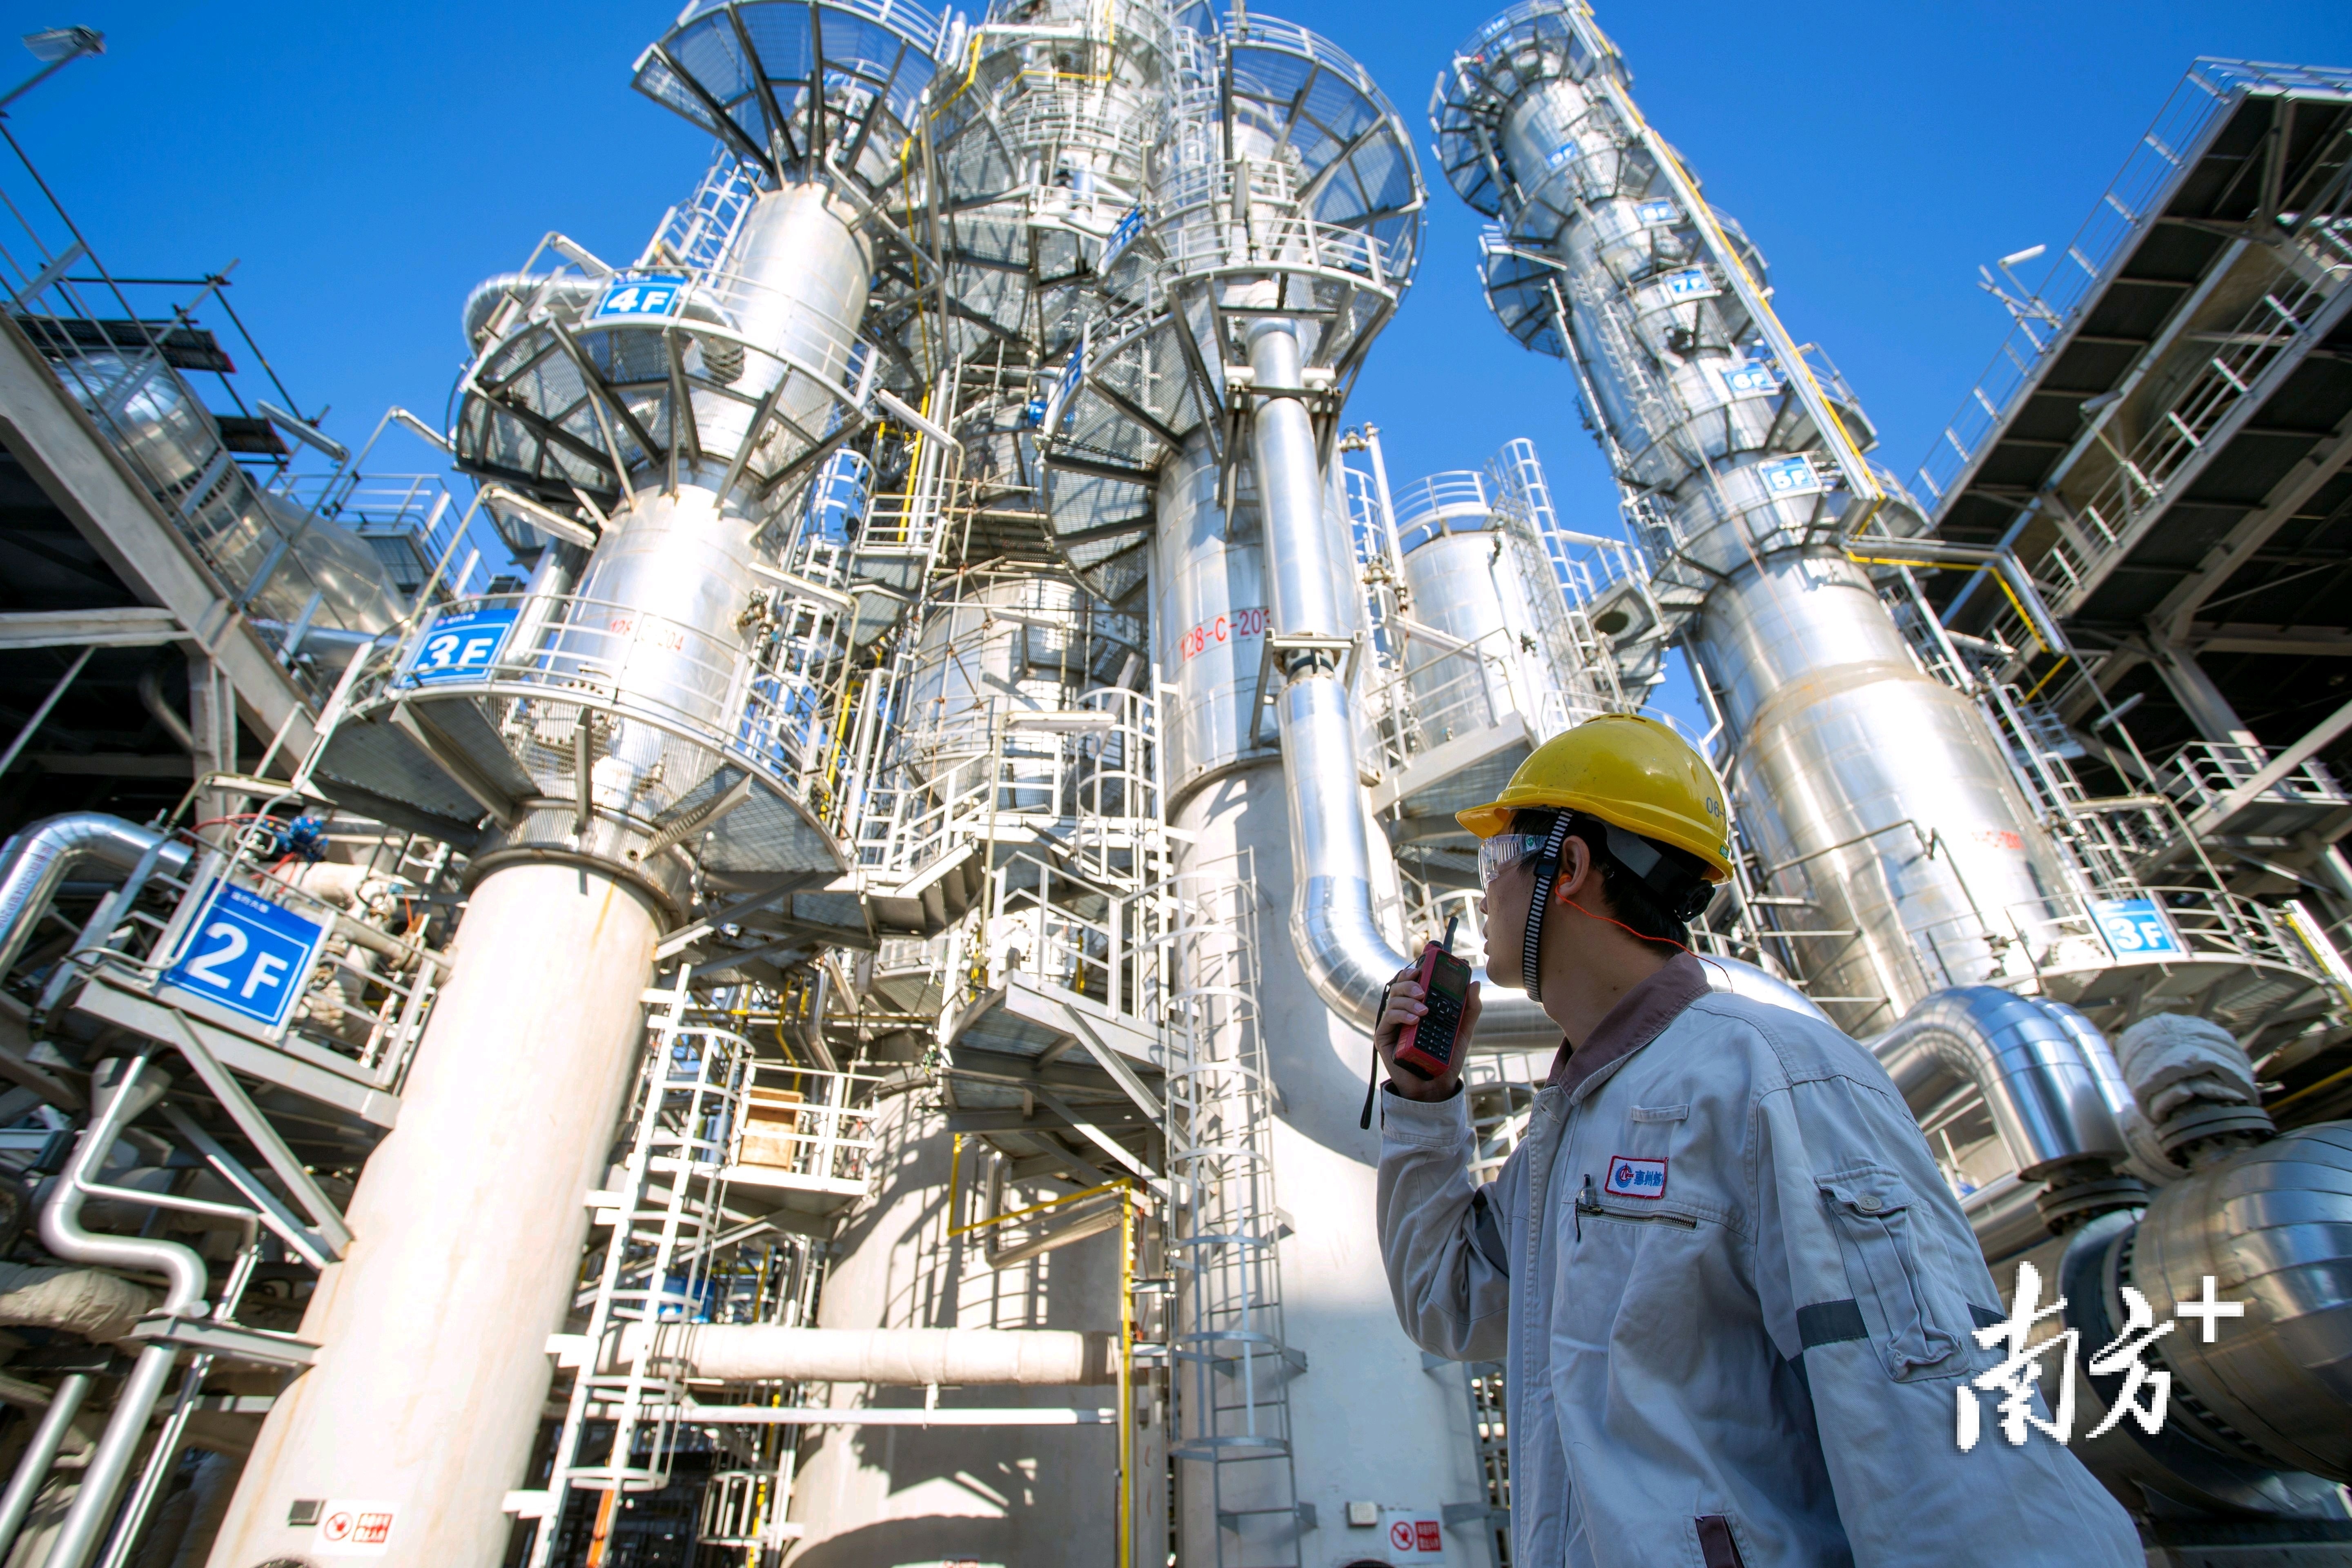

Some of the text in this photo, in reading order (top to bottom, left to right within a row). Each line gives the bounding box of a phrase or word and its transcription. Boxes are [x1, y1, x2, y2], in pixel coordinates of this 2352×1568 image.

[1551, 147, 1572, 164] 9F
[1674, 276, 1703, 293] 7F
[607, 287, 670, 312] 4F
[1732, 373, 1766, 390] 6F
[1770, 470, 1807, 489] 5F
[416, 634, 494, 676] 3F
[2108, 918, 2163, 950] 3F
[183, 922, 289, 999] 2F
